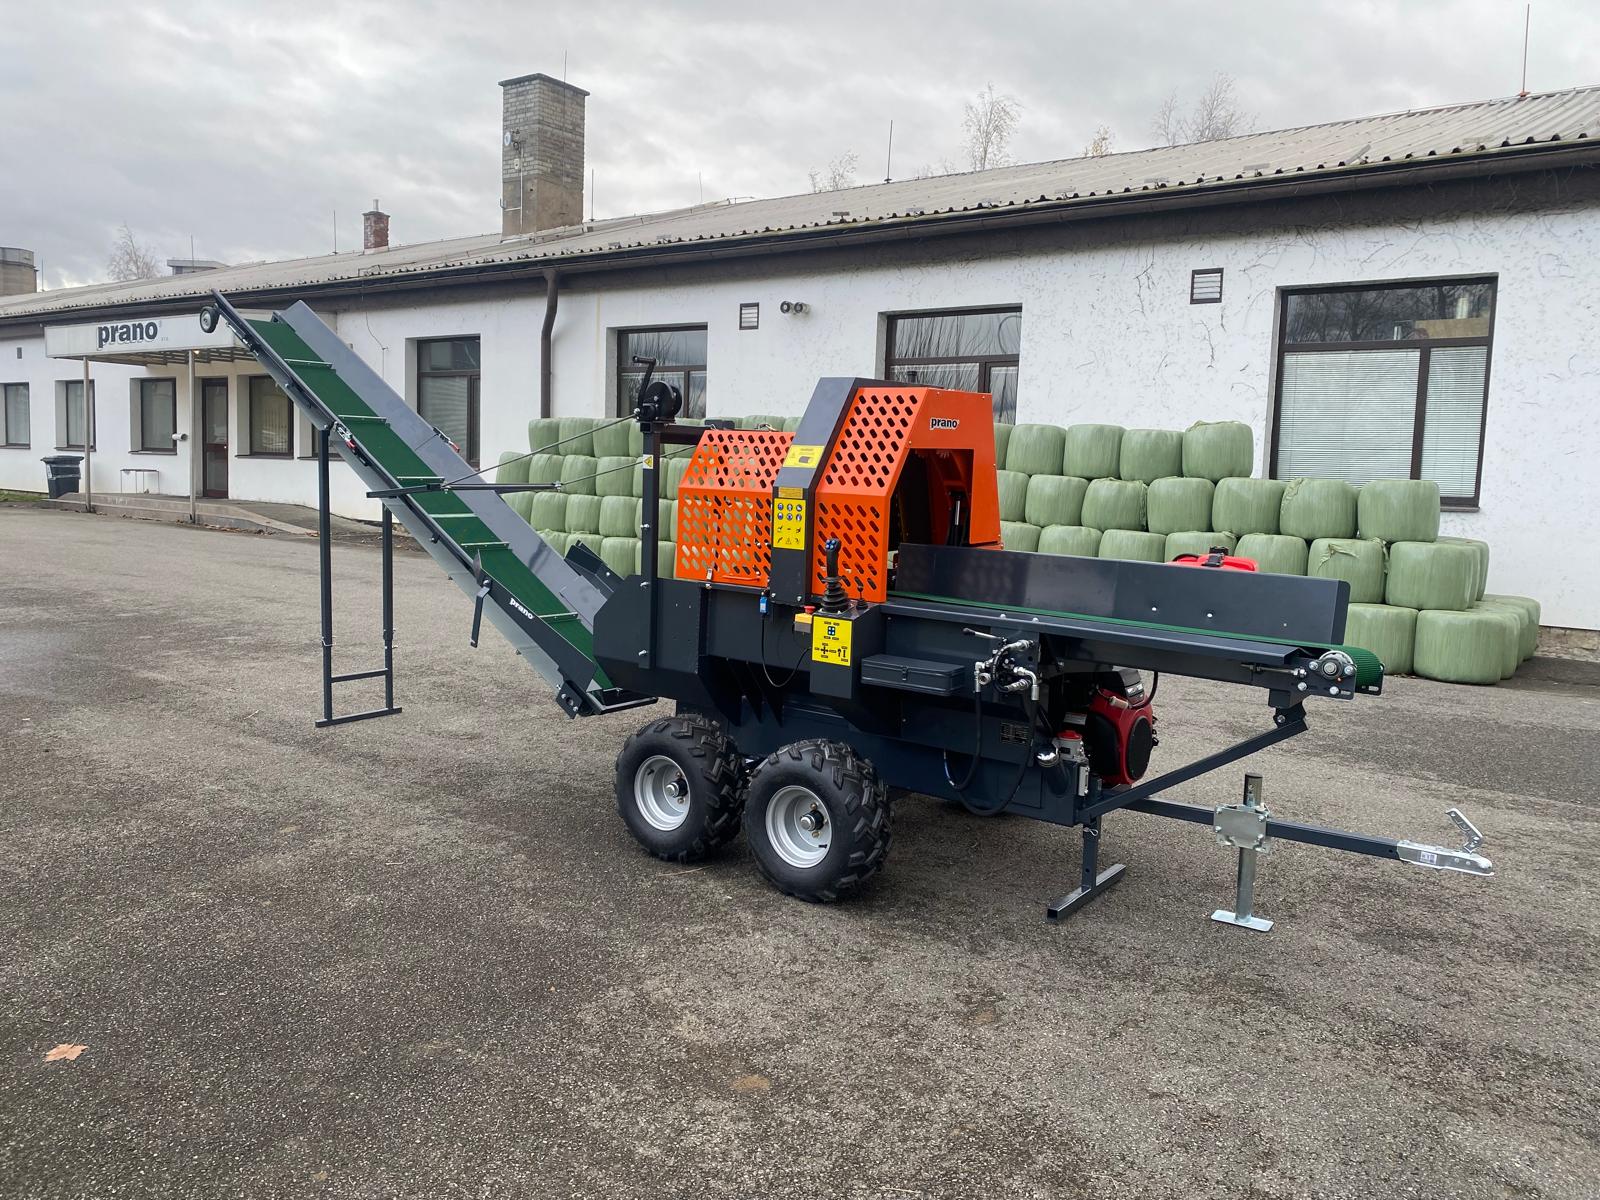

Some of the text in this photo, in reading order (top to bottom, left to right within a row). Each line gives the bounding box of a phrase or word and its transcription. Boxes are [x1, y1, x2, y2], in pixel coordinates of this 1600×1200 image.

[97, 321, 158, 349] prano
[930, 417, 959, 430] prano
[509, 597, 534, 620] prano
